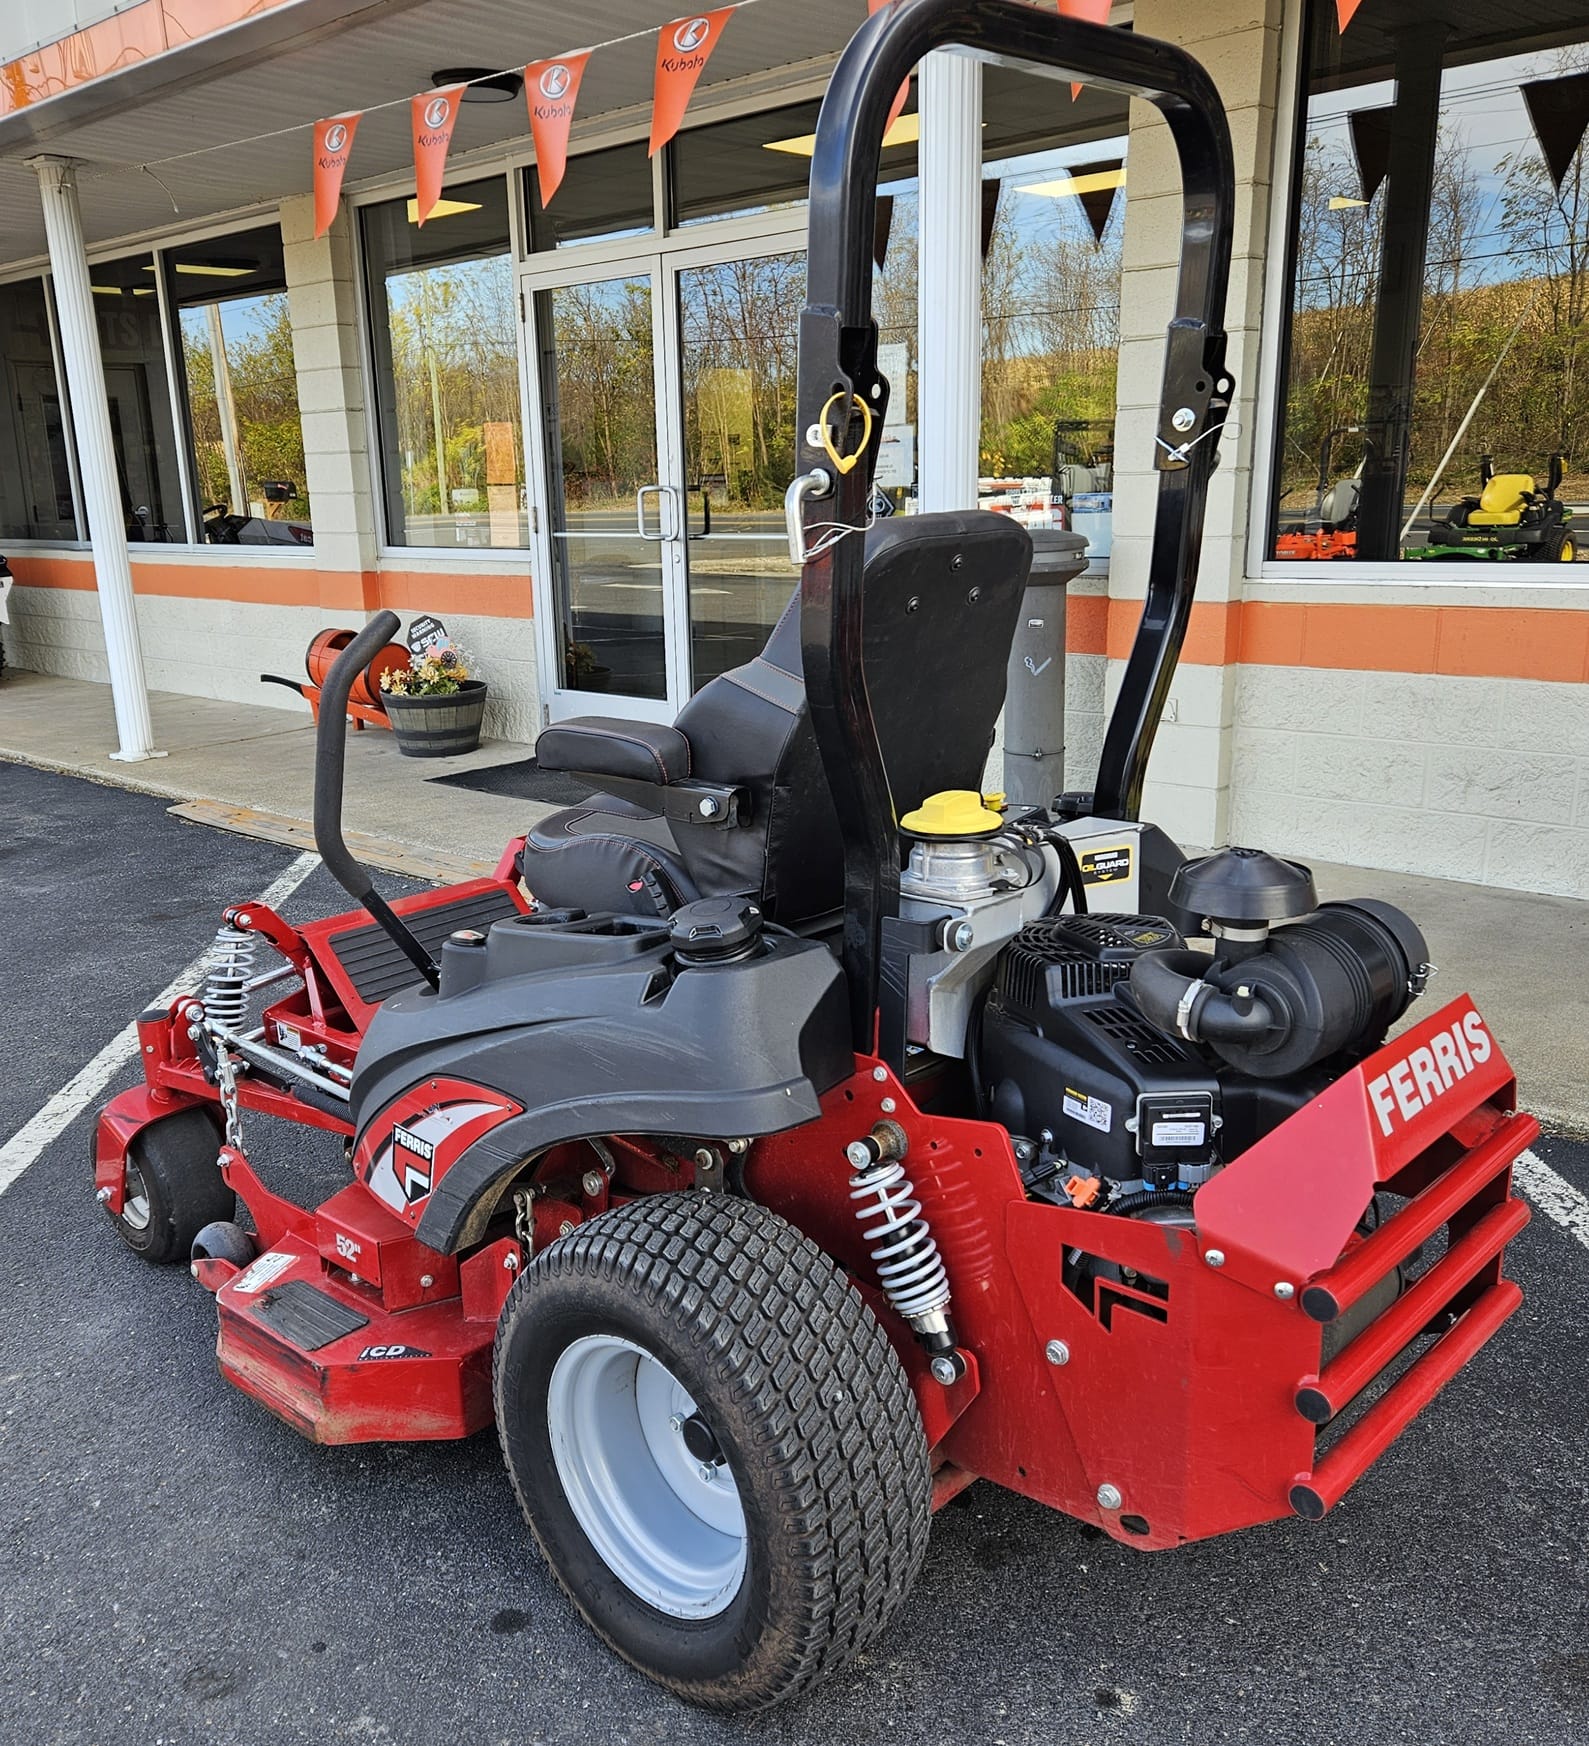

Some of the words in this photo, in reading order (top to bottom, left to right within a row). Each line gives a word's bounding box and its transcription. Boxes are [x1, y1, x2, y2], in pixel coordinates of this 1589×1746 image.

[661, 56, 704, 72] Kubota
[534, 104, 571, 119] Kubota
[418, 132, 449, 147] Kubota
[319, 156, 346, 169] Kubota
[1367, 1010, 1491, 1137] FERRIS
[394, 1127, 433, 1159] FERRIS
[336, 1232, 361, 1263] 52"
